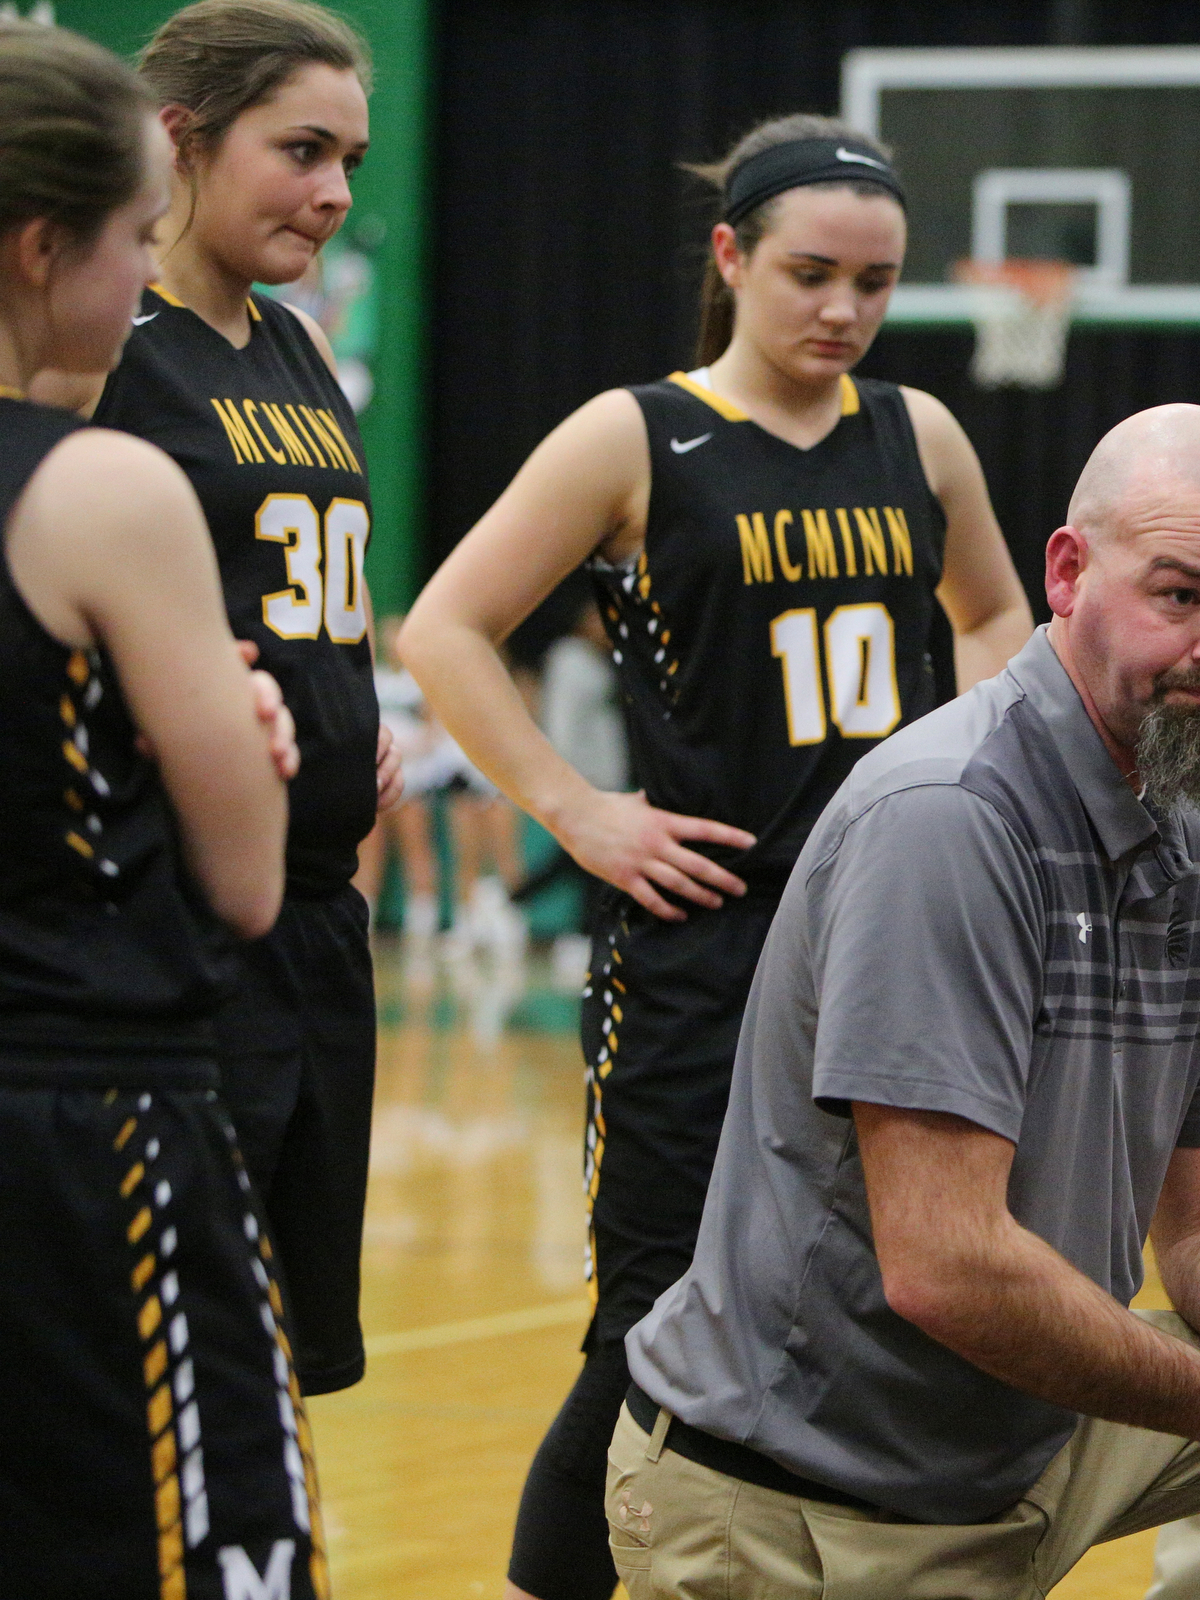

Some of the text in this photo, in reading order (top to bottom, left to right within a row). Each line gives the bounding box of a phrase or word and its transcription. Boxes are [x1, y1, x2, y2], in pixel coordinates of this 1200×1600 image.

[211, 398, 363, 476] MCMINN
[254, 492, 370, 645] 30
[735, 506, 914, 586] MCMINN
[769, 602, 902, 747] 10
